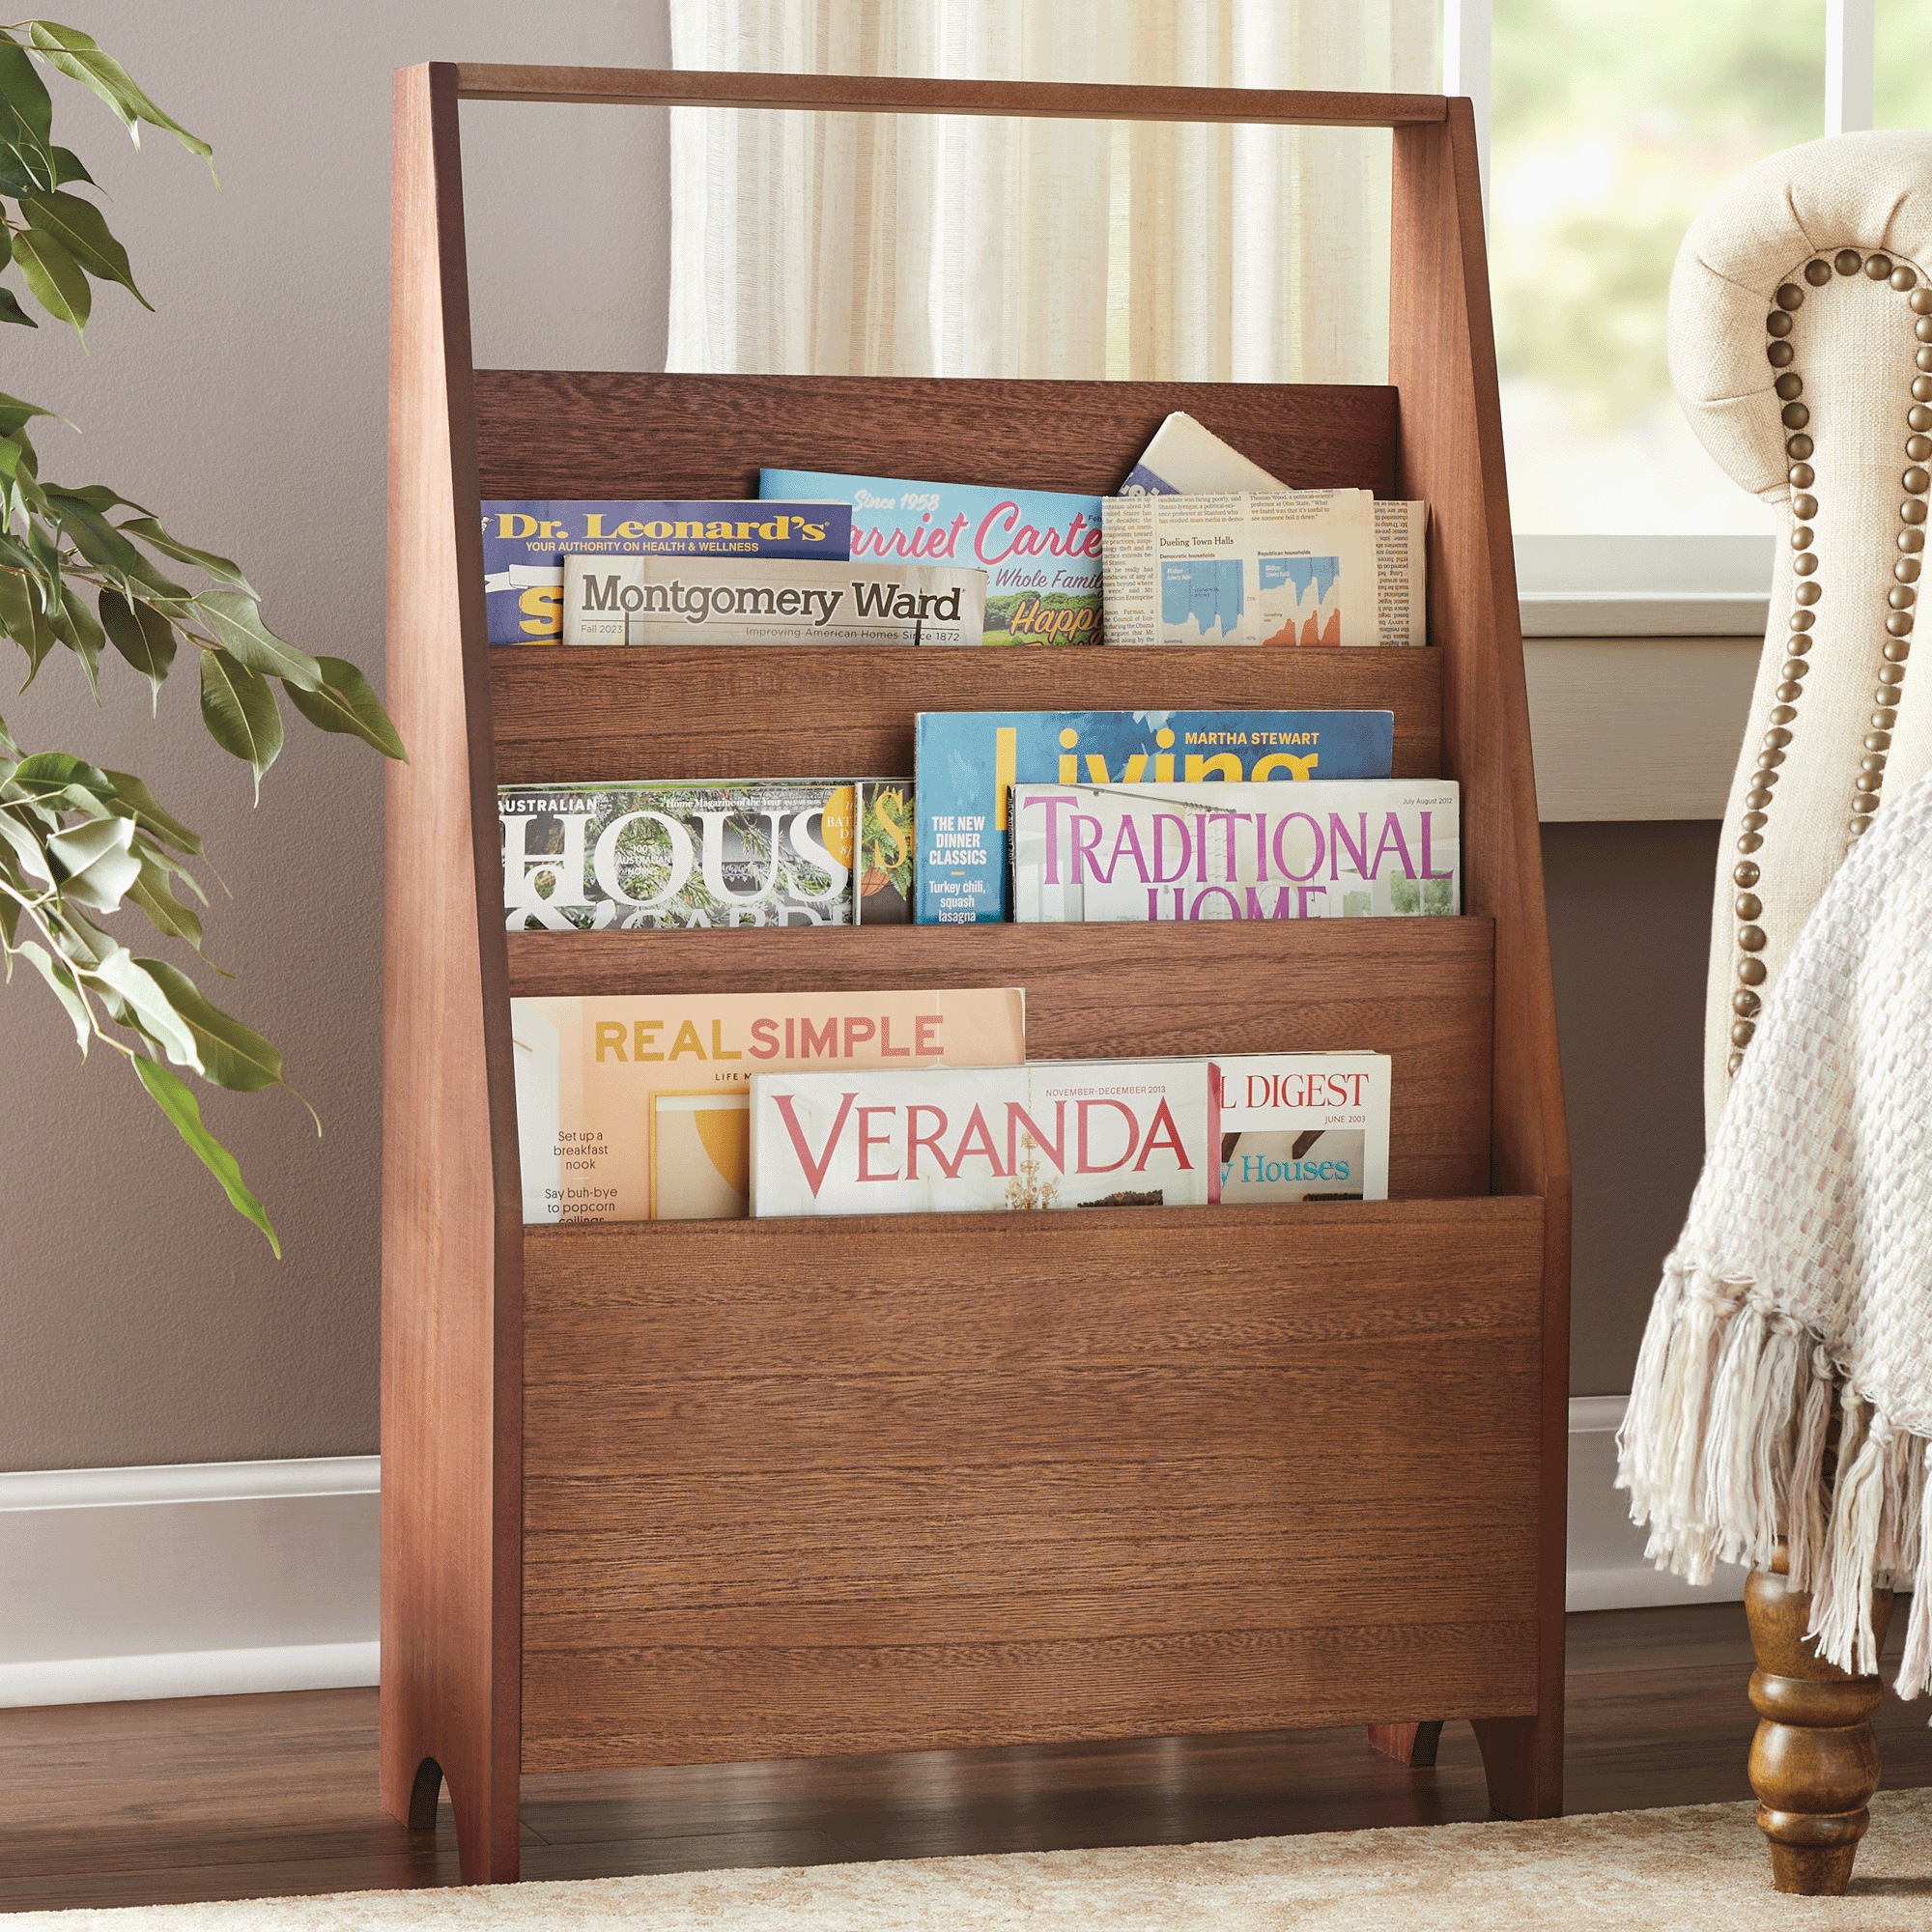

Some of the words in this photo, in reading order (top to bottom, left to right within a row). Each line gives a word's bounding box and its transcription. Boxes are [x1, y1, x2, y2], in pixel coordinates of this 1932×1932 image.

[852, 489, 895, 512] Since
[900, 493, 940, 511] 1958
[494, 513, 568, 539] Dr.
[582, 513, 826, 542] Leonard's
[526, 542, 555, 551] YOUR
[558, 542, 621, 551] AUTHORITY
[623, 542, 640, 551] ON
[643, 542, 685, 552] HEALTH
[688, 542, 696, 552] &
[699, 542, 759, 552] WELLNESS
[1160, 537, 1190, 548] Dueling
[1191, 537, 1212, 546] Town
[1215, 536, 1234, 545] Halls
[996, 568, 1048, 588] Whole
[582, 574, 843, 626] Montgomery
[852, 582, 961, 621] Ward
[581, 624, 597, 634] Fall
[599, 625, 624, 634] 2023
[746, 627, 801, 640] Improving
[805, 628, 857, 638] American
[861, 630, 898, 639] Homes
[902, 631, 932, 640] Since
[936, 632, 960, 641] 1872
[1185, 732, 1247, 745] MARTHA
[1251, 732, 1319, 745] STEWART
[761, 797, 781, 806] Year
[1416, 798, 1437, 806] August
[932, 816, 955, 831] THE
[958, 816, 985, 831] NEW
[936, 833, 981, 848] DINNER
[1023, 796, 1454, 884] TRADITIONAL
[929, 850, 987, 866] CLASSICS
[929, 881, 961, 896] Turkey
[963, 880, 986, 894] chili,
[940, 895, 975, 910] squash
[939, 910, 976, 924] lasagna
[595, 1019, 742, 1063] REAL
[748, 1015, 945, 1060] SIMPLE
[1046, 1086, 1146, 1097] NOVEMBER-DECEMBER
[1148, 1085, 1166, 1093] 2013
[1246, 1074, 1369, 1108] DIGEST
[1325, 1116, 1345, 1125] JUNE
[558, 1131, 576, 1141] Set
[579, 1132, 594, 1143] up
[554, 1145, 608, 1156] breakfast
[771, 1093, 1194, 1200] VERANDA
[566, 1159, 596, 1170] nook
[1241, 1154, 1350, 1183] Houses
[545, 1188, 564, 1200] Say
[567, 1187, 618, 1199] buh-bye
[548, 1204, 560, 1213] to
[563, 1203, 615, 1214] popcorn
